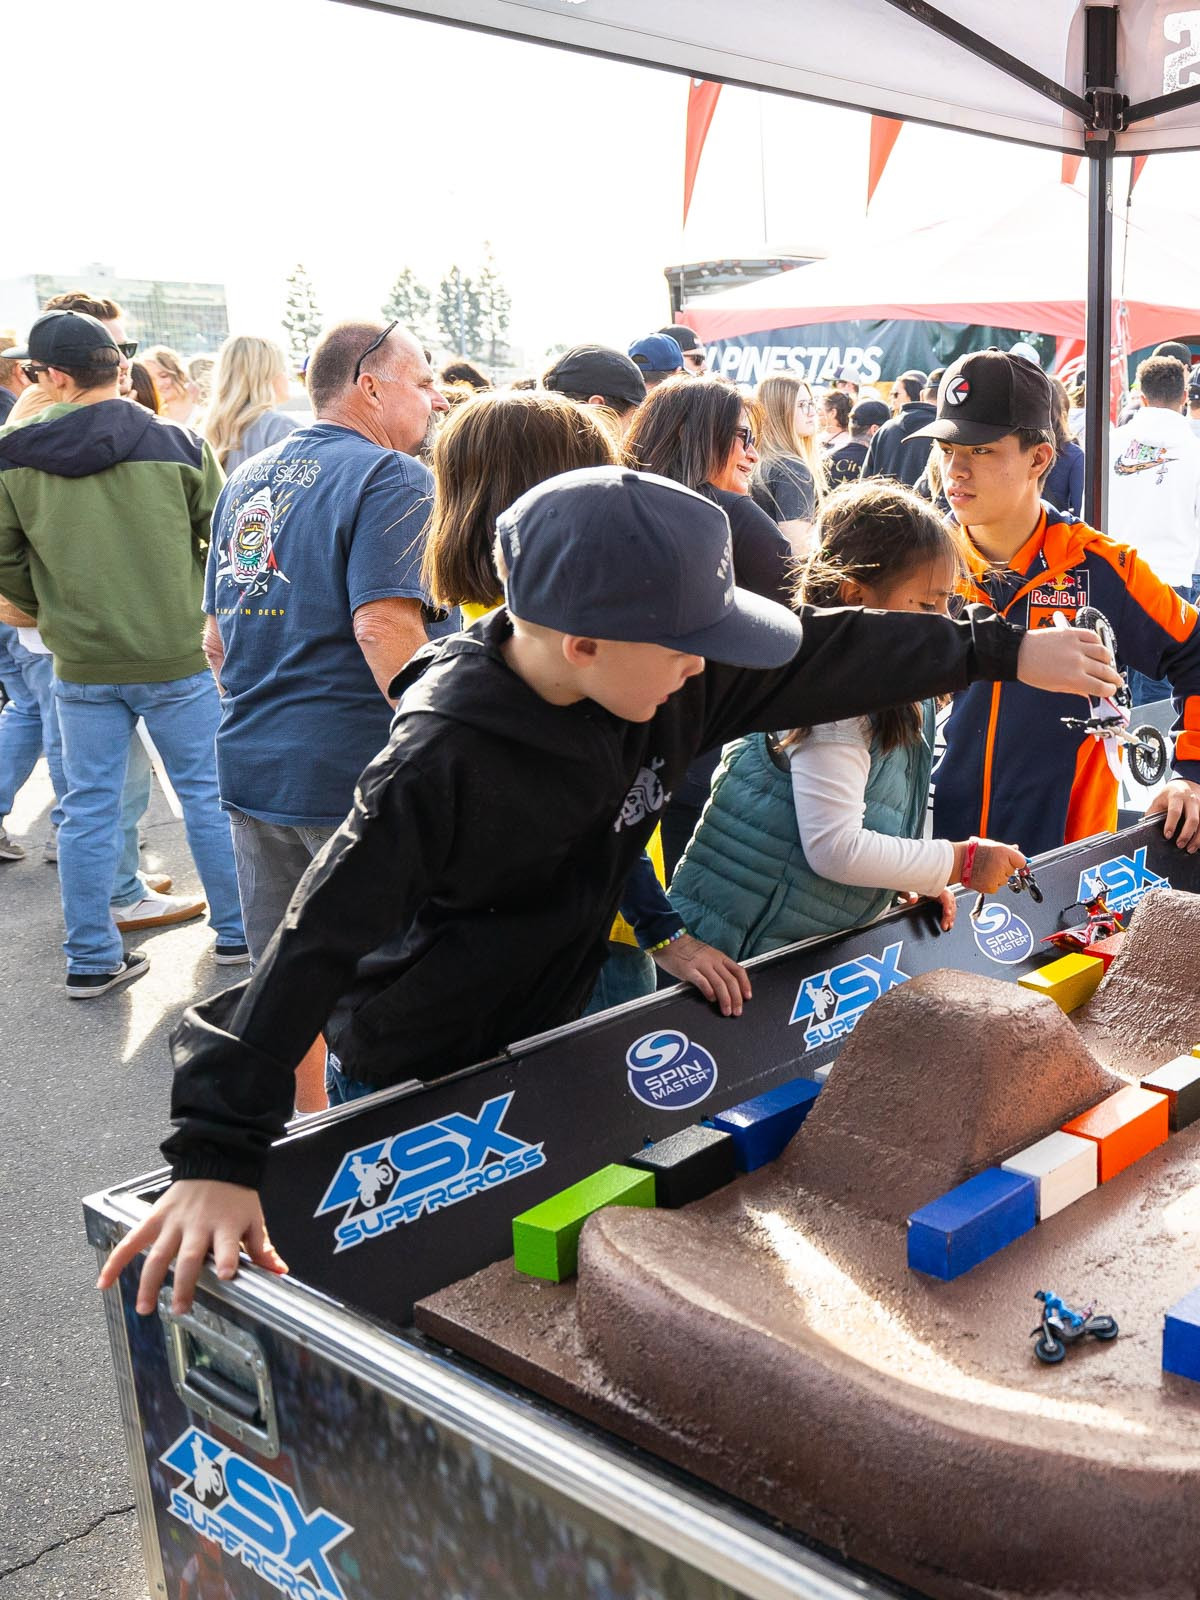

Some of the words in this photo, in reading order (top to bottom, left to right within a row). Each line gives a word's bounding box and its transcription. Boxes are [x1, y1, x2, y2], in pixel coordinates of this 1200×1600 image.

[274, 465, 321, 488] SEAS
[258, 608, 285, 616] DEEP
[985, 927, 1022, 948] SPIN
[644, 1059, 703, 1091] SPIN
[333, 1142, 547, 1254] SUPERCROSS
